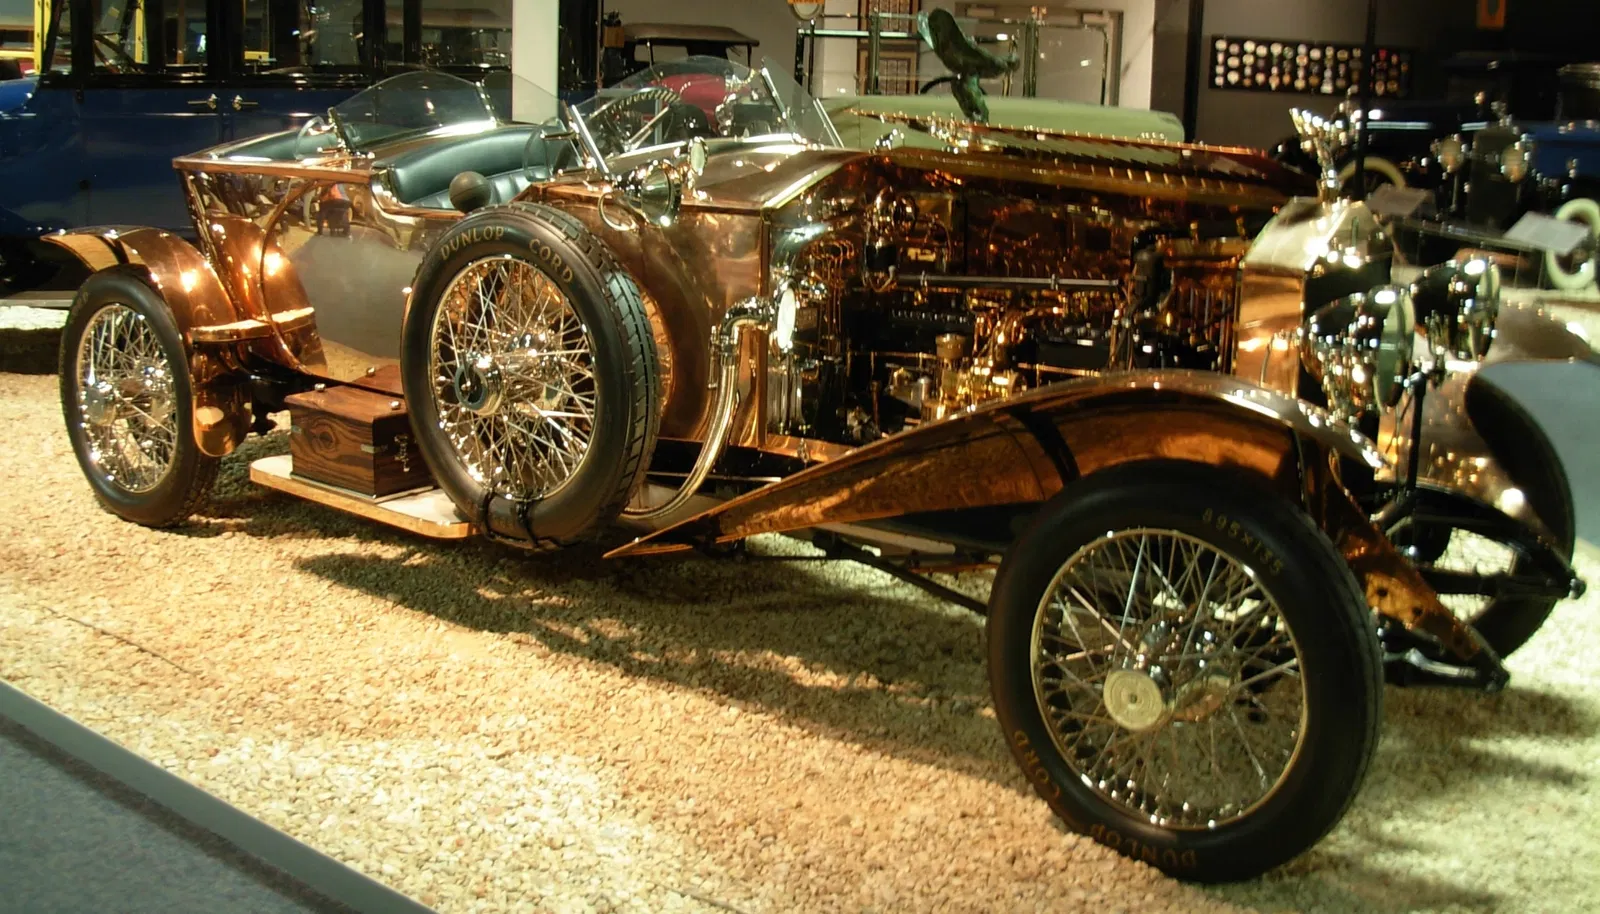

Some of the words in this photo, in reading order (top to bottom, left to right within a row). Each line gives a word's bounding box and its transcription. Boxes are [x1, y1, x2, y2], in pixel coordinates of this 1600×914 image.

[440, 225, 505, 261] DUNLOP
[528, 238, 574, 284] CORD
[1014, 730, 1061, 799] CORD
[1090, 824, 1197, 868] DUNLOP
